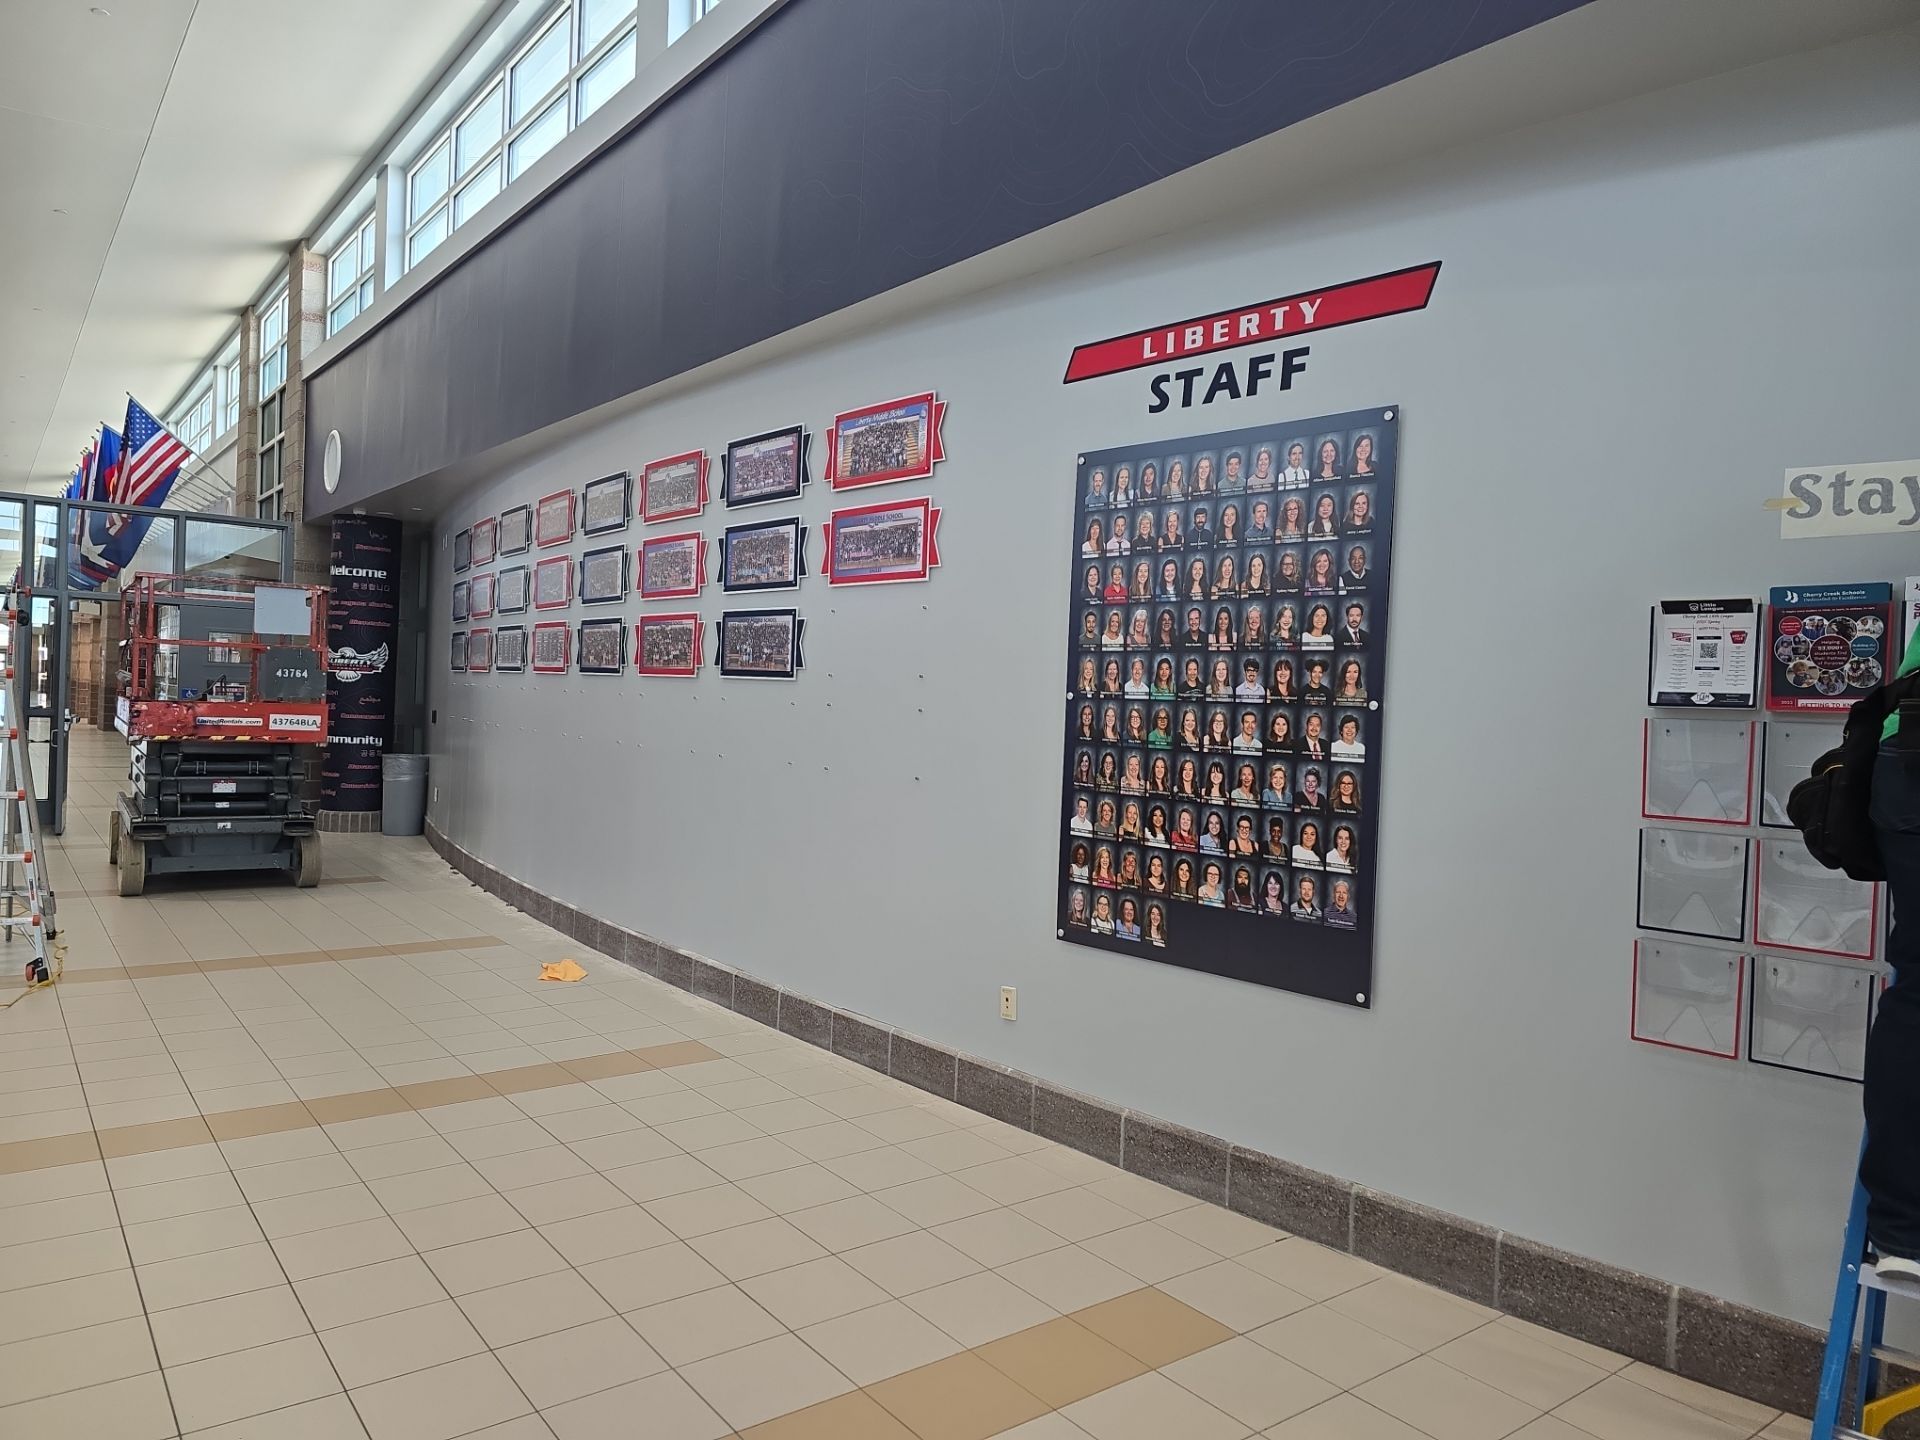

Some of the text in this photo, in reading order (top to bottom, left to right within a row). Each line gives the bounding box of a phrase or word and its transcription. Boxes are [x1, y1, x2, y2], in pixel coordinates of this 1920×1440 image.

[1143, 298, 1322, 359] LIBERTY
[1149, 346, 1310, 413] STAFF
[330, 564, 387, 579] Welcome
[275, 668, 309, 679] 43764
[271, 717, 318, 728] 43764BLA
